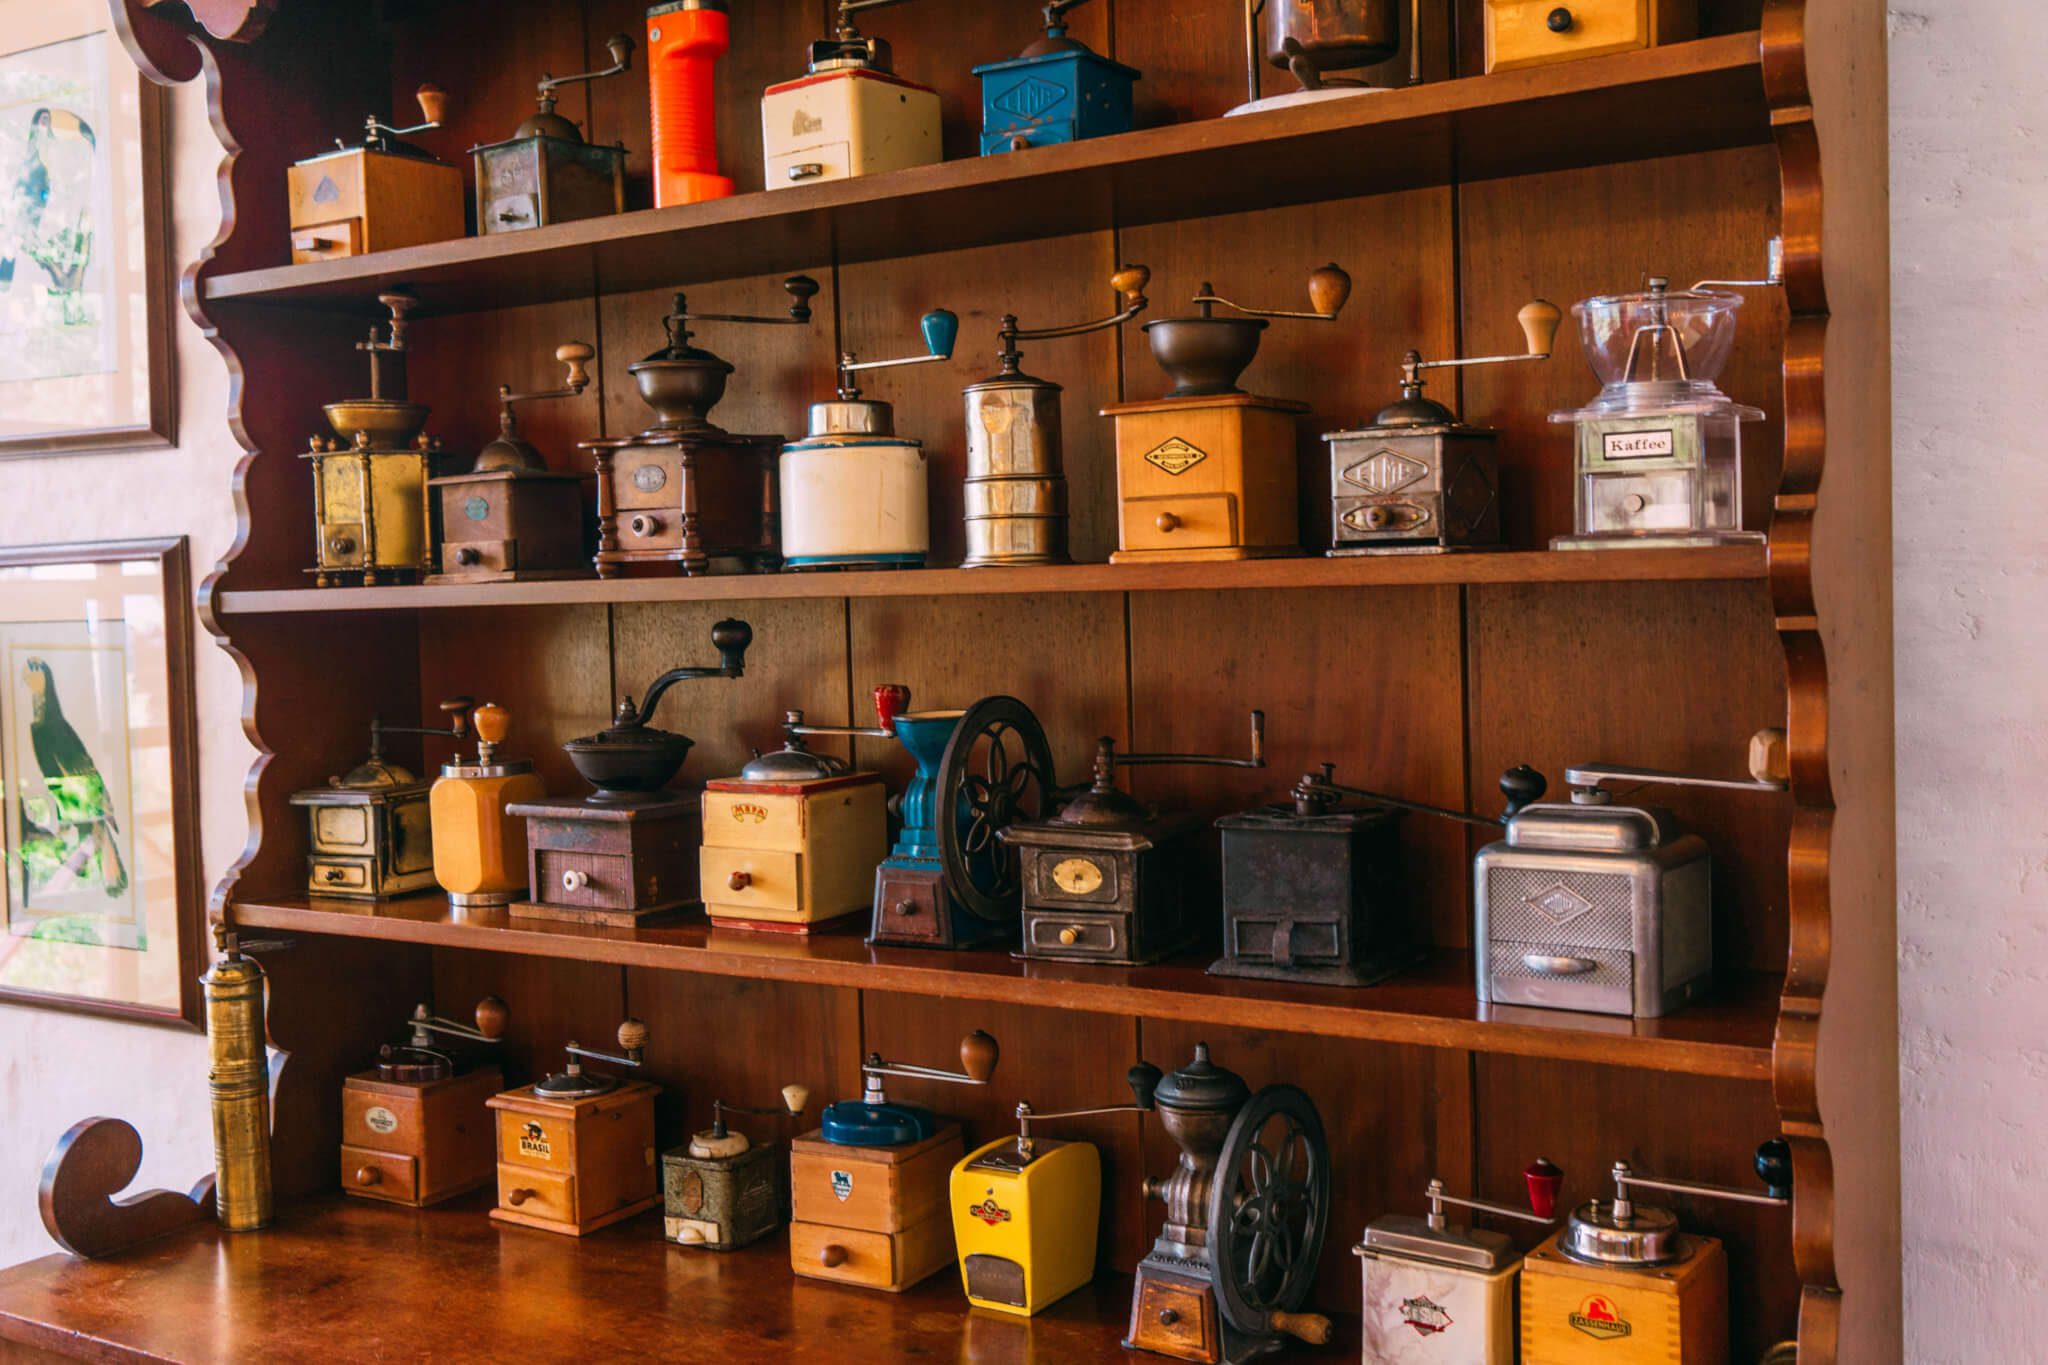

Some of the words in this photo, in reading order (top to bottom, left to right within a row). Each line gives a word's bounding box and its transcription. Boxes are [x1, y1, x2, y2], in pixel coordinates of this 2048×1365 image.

[1610, 439, 1666, 452] Kaffee
[521, 1141, 551, 1154] BRASIL
[1572, 1314, 1628, 1334] ZASSENHAUS
